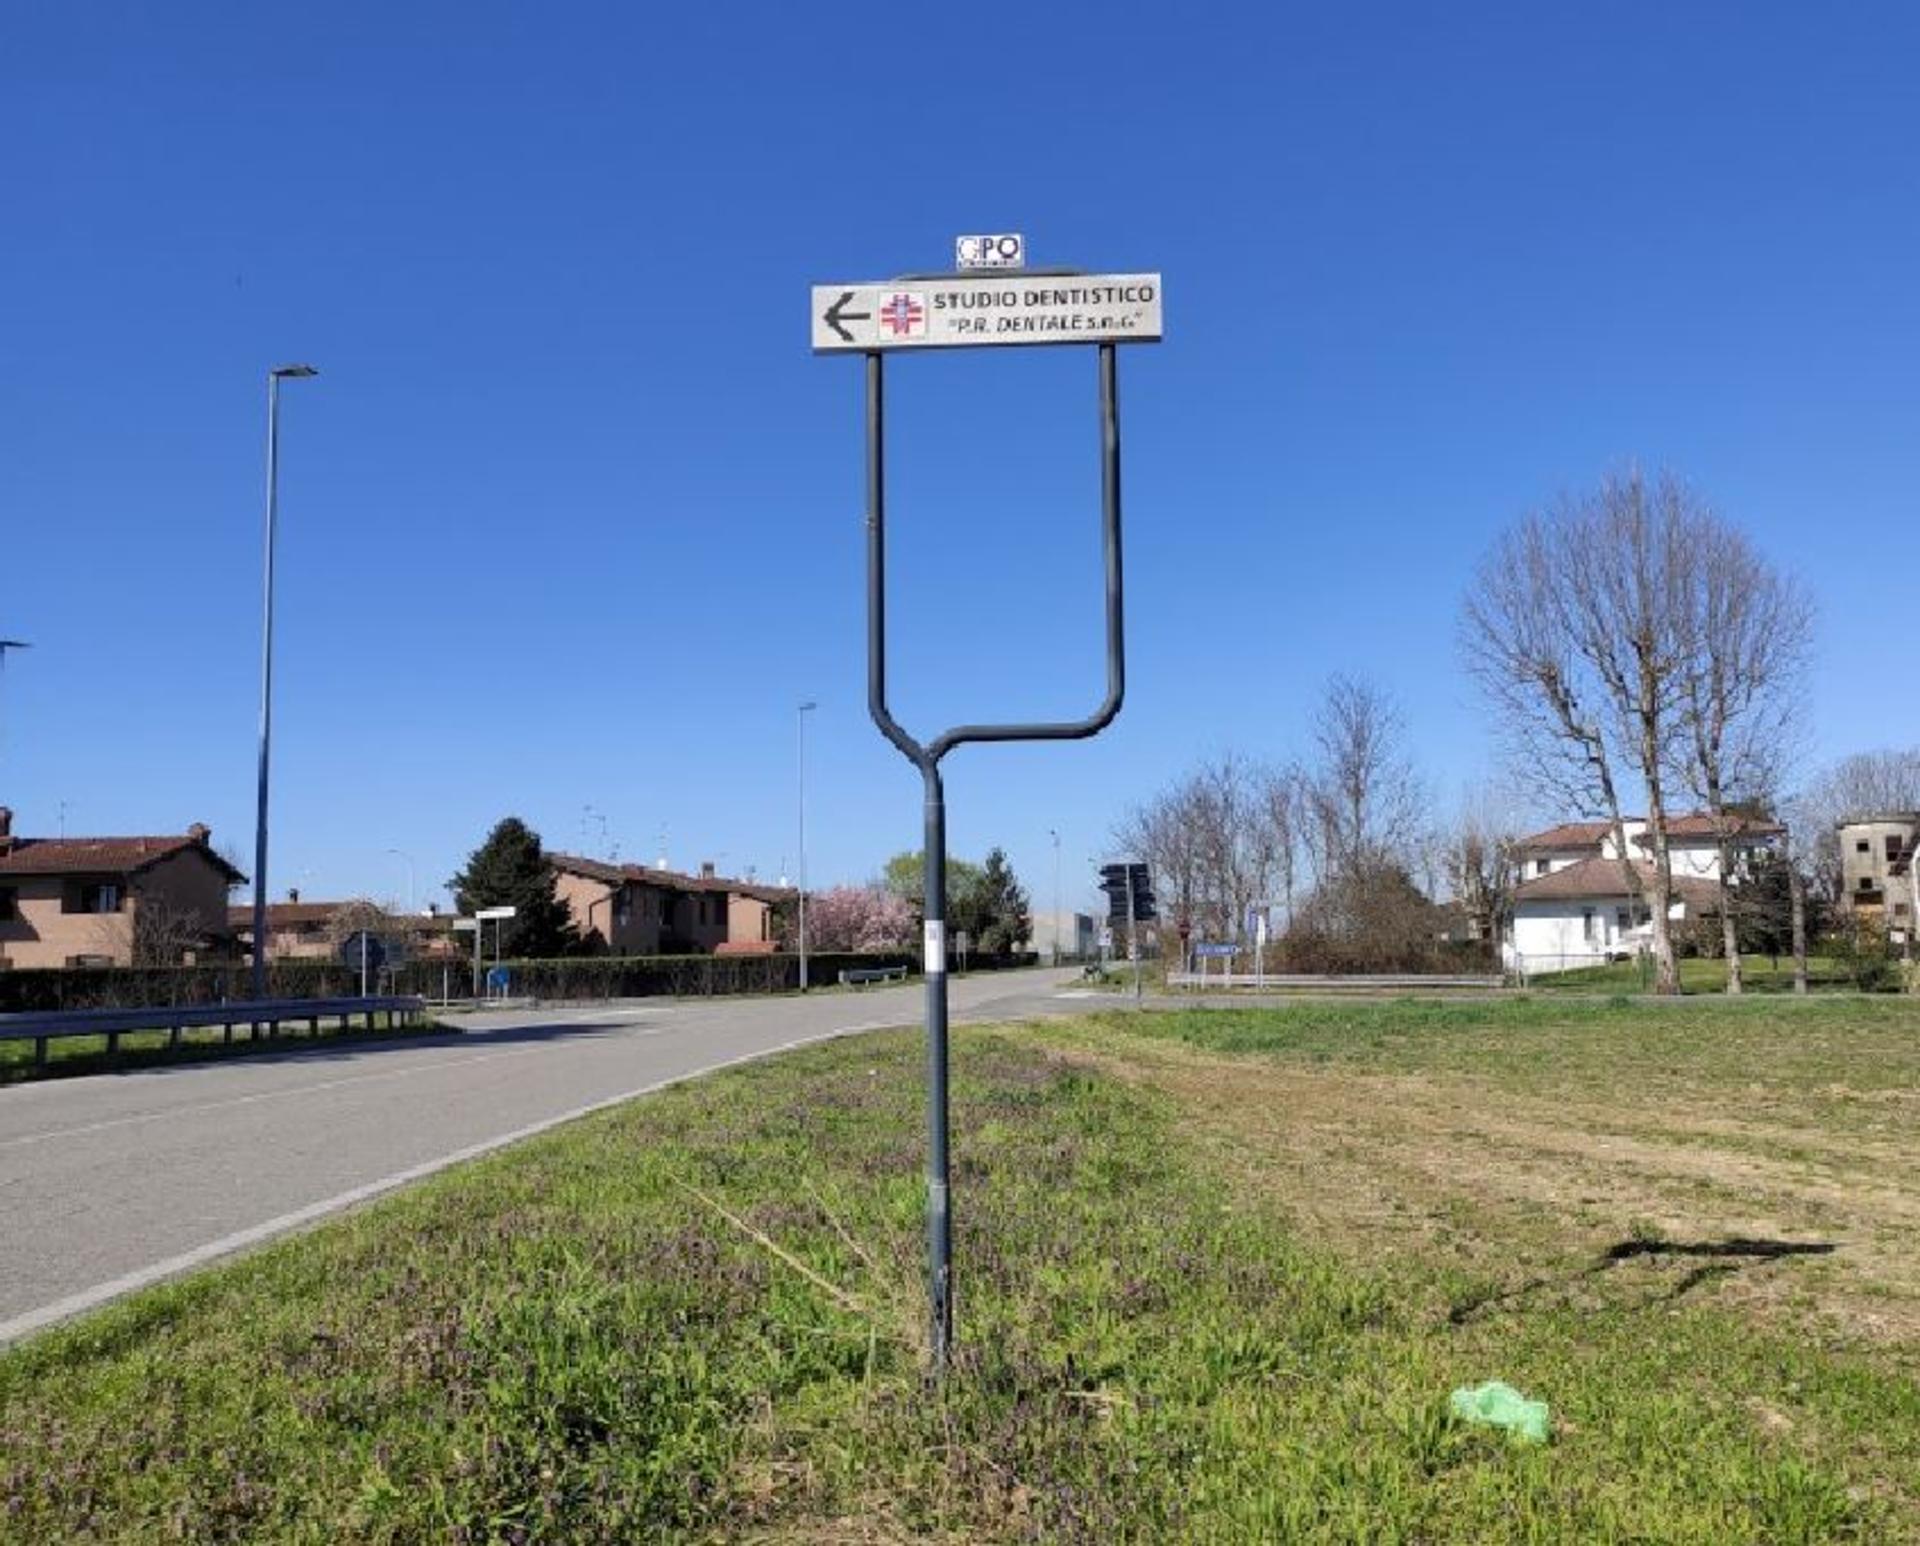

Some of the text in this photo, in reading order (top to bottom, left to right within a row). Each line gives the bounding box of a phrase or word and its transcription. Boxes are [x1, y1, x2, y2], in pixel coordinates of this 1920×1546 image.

[934, 286, 1154, 309] STUDIO DENTISTICO
[997, 314, 1082, 333] DENTALE
